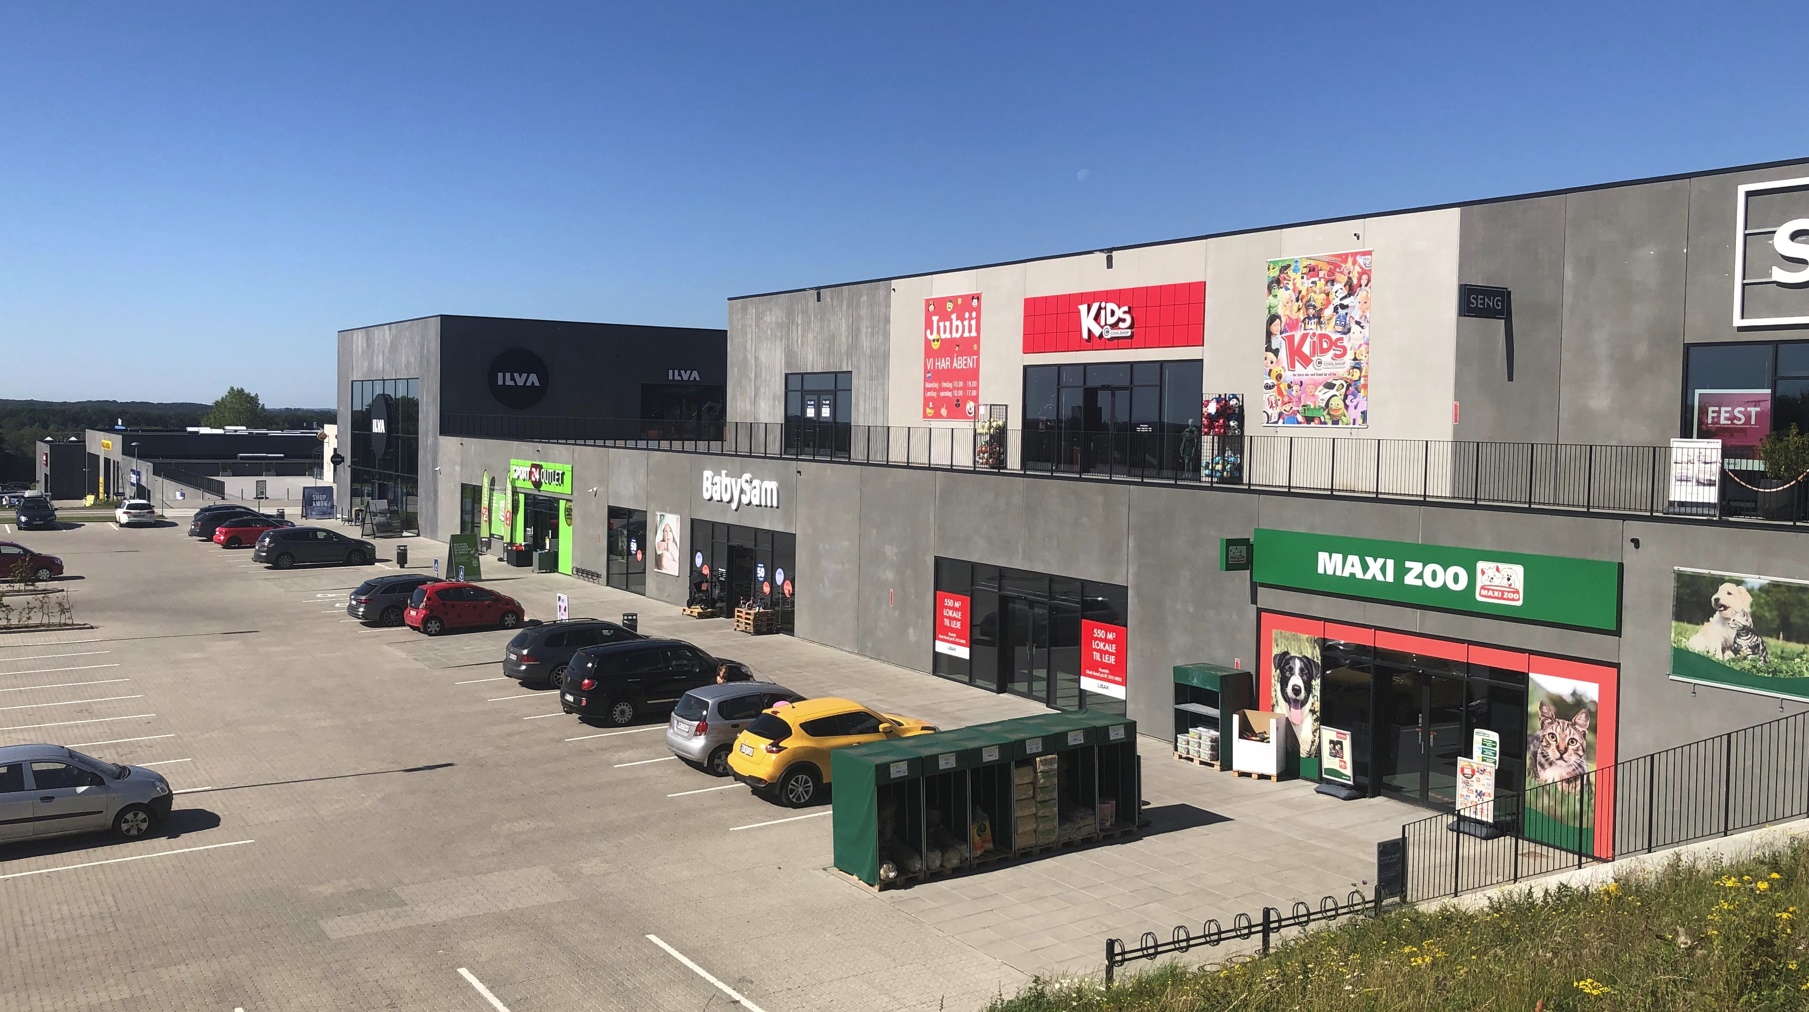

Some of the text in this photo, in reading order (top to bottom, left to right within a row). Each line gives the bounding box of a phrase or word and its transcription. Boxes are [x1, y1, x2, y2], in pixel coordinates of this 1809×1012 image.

[1772, 218, 1809, 283] S
[1469, 294, 1502, 310] SENG
[926, 311, 977, 340] Jubii
[926, 353, 978, 370] VI HAR ÅBENT
[497, 372, 541, 387] ILVA
[668, 369, 700, 381] ILVA
[1707, 406, 1761, 425] FEST
[372, 419, 385, 434] ILVA
[512, 465, 564, 485] SPORT 24 OUTLET
[702, 469, 779, 511] BabySam
[756, 566, 765, 578] 50
[1317, 551, 1468, 591] MAXI ZOO
[1480, 588, 1519, 600] MAXI ZOO
[943, 598, 954, 607] 550
[943, 608, 962, 619] LOKALE
[950, 620, 961, 630] LEJE
[1092, 628, 1116, 640] 550 M²
[1091, 640, 1117, 653] LOKALE
[1092, 651, 1116, 665] TIL LEJE
